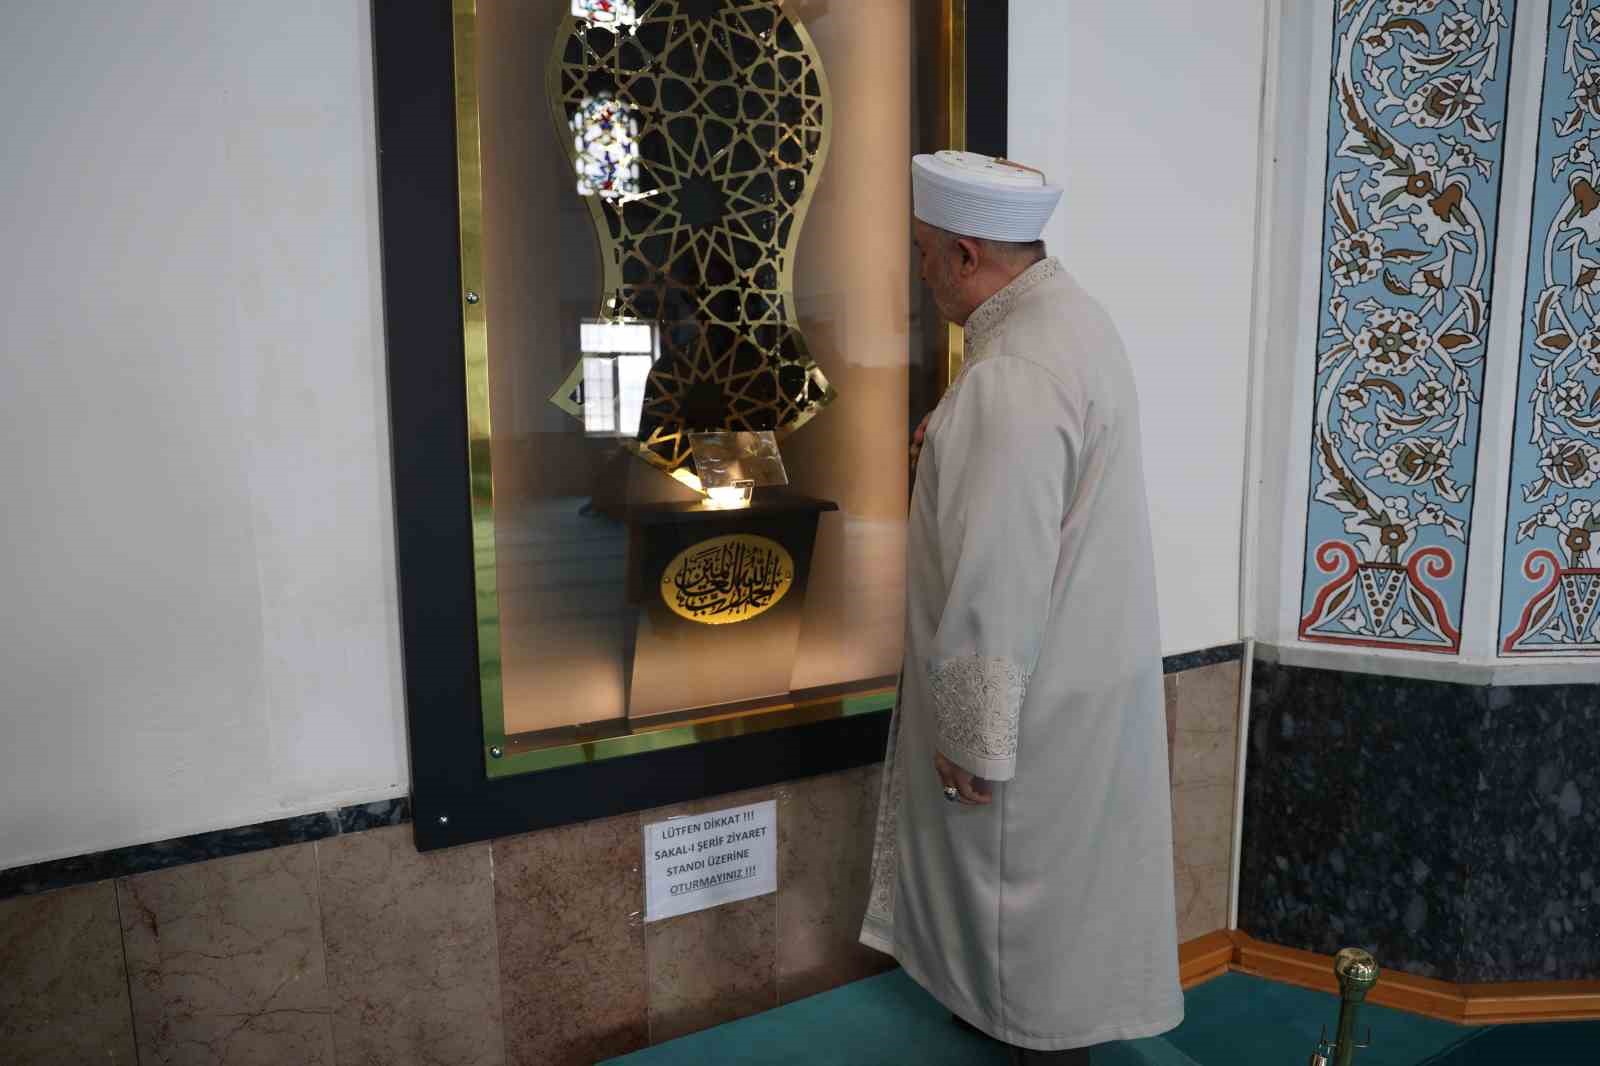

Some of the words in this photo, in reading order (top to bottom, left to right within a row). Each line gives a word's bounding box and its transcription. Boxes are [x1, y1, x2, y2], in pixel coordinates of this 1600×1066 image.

[662, 823, 701, 840] LÜTFEN
[703, 814, 741, 831] DİKKAT
[743, 810, 755, 821] !!!
[655, 843, 695, 861] SAKAL-I
[697, 835, 725, 853] ŞERİF
[726, 826, 768, 844] ZİYARET
[666, 860, 705, 877] STANDI
[707, 848, 750, 867] ÜZERİNE
[670, 869, 742, 895] OTURMAYINIZ
[745, 865, 757, 878] !!!
